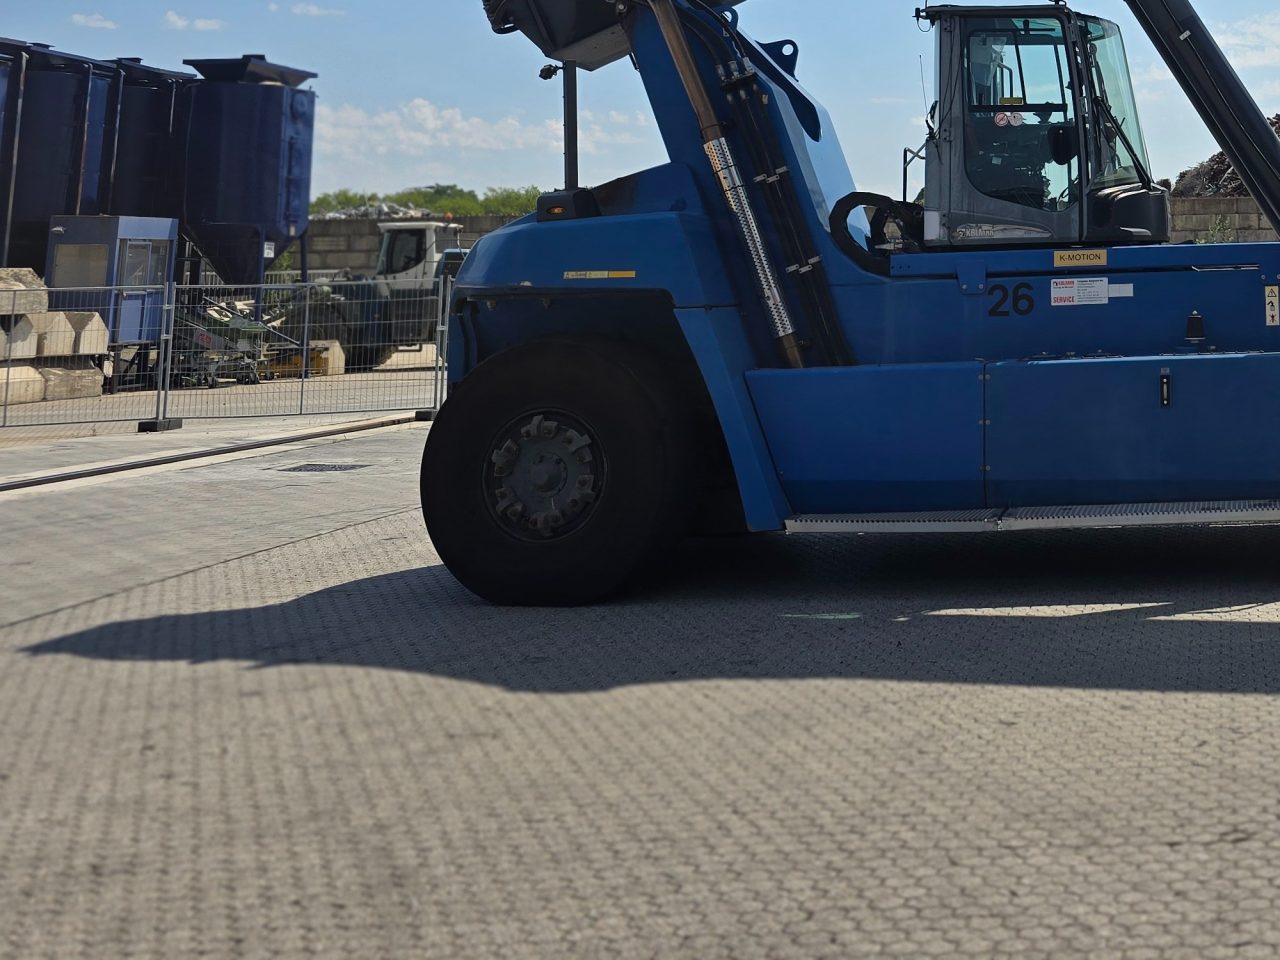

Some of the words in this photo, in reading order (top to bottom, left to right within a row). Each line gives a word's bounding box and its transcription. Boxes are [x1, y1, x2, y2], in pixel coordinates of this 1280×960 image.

[1059, 253, 1101, 262] K-MOTION
[988, 282, 1034, 317] 26
[1053, 295, 1075, 304] SERVICE
